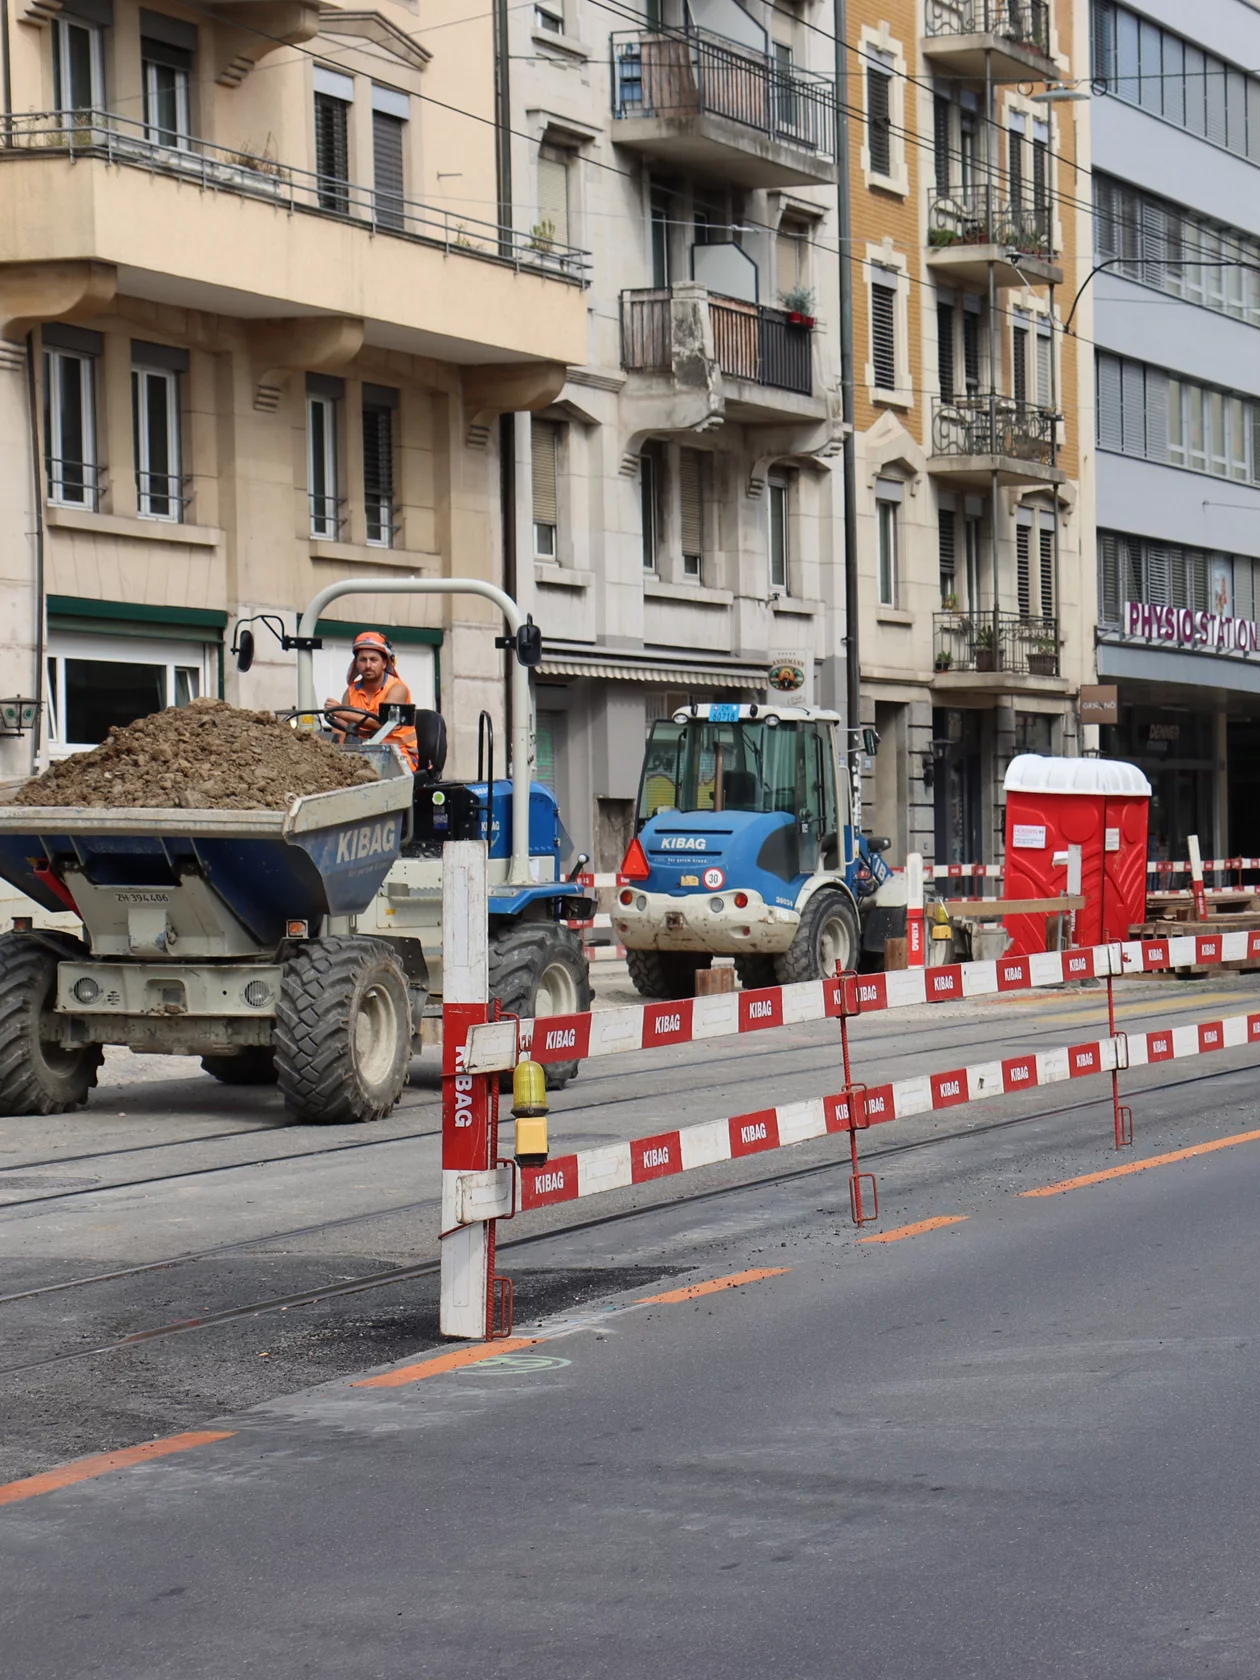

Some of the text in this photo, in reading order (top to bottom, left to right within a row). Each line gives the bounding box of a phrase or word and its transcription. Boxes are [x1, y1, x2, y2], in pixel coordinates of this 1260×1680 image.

[1125, 601, 1258, 652] PHYSIO STATION
[712, 712, 735, 721] 60718
[481, 820, 500, 832] KIAG
[336, 820, 395, 864] KIBAG
[661, 837, 707, 850] KIBAG
[708, 873, 719, 884] 30
[911, 922, 919, 951] KIBAG
[1148, 948, 1163, 961] KIBAG
[1201, 943, 1216, 956] KIBAG
[1069, 957, 1087, 972] KIBAG
[1004, 966, 1022, 981] KIBAG
[934, 975, 954, 991] KIBAG
[749, 1000, 773, 1019] KIBAG
[654, 1014, 681, 1034] KIBAG
[546, 1028, 576, 1050] KIBAG
[1204, 1030, 1218, 1043] KIBAG
[1152, 1039, 1167, 1053] KIBAG
[1076, 1052, 1093, 1068] KIBAG
[1010, 1065, 1029, 1081] KIBAG
[939, 1080, 960, 1097] KIBAG
[834, 1103, 849, 1121] KIB
[741, 1122, 767, 1144] KIBAG
[643, 1147, 669, 1168] KIBAG
[535, 1171, 564, 1194] KIBAG
